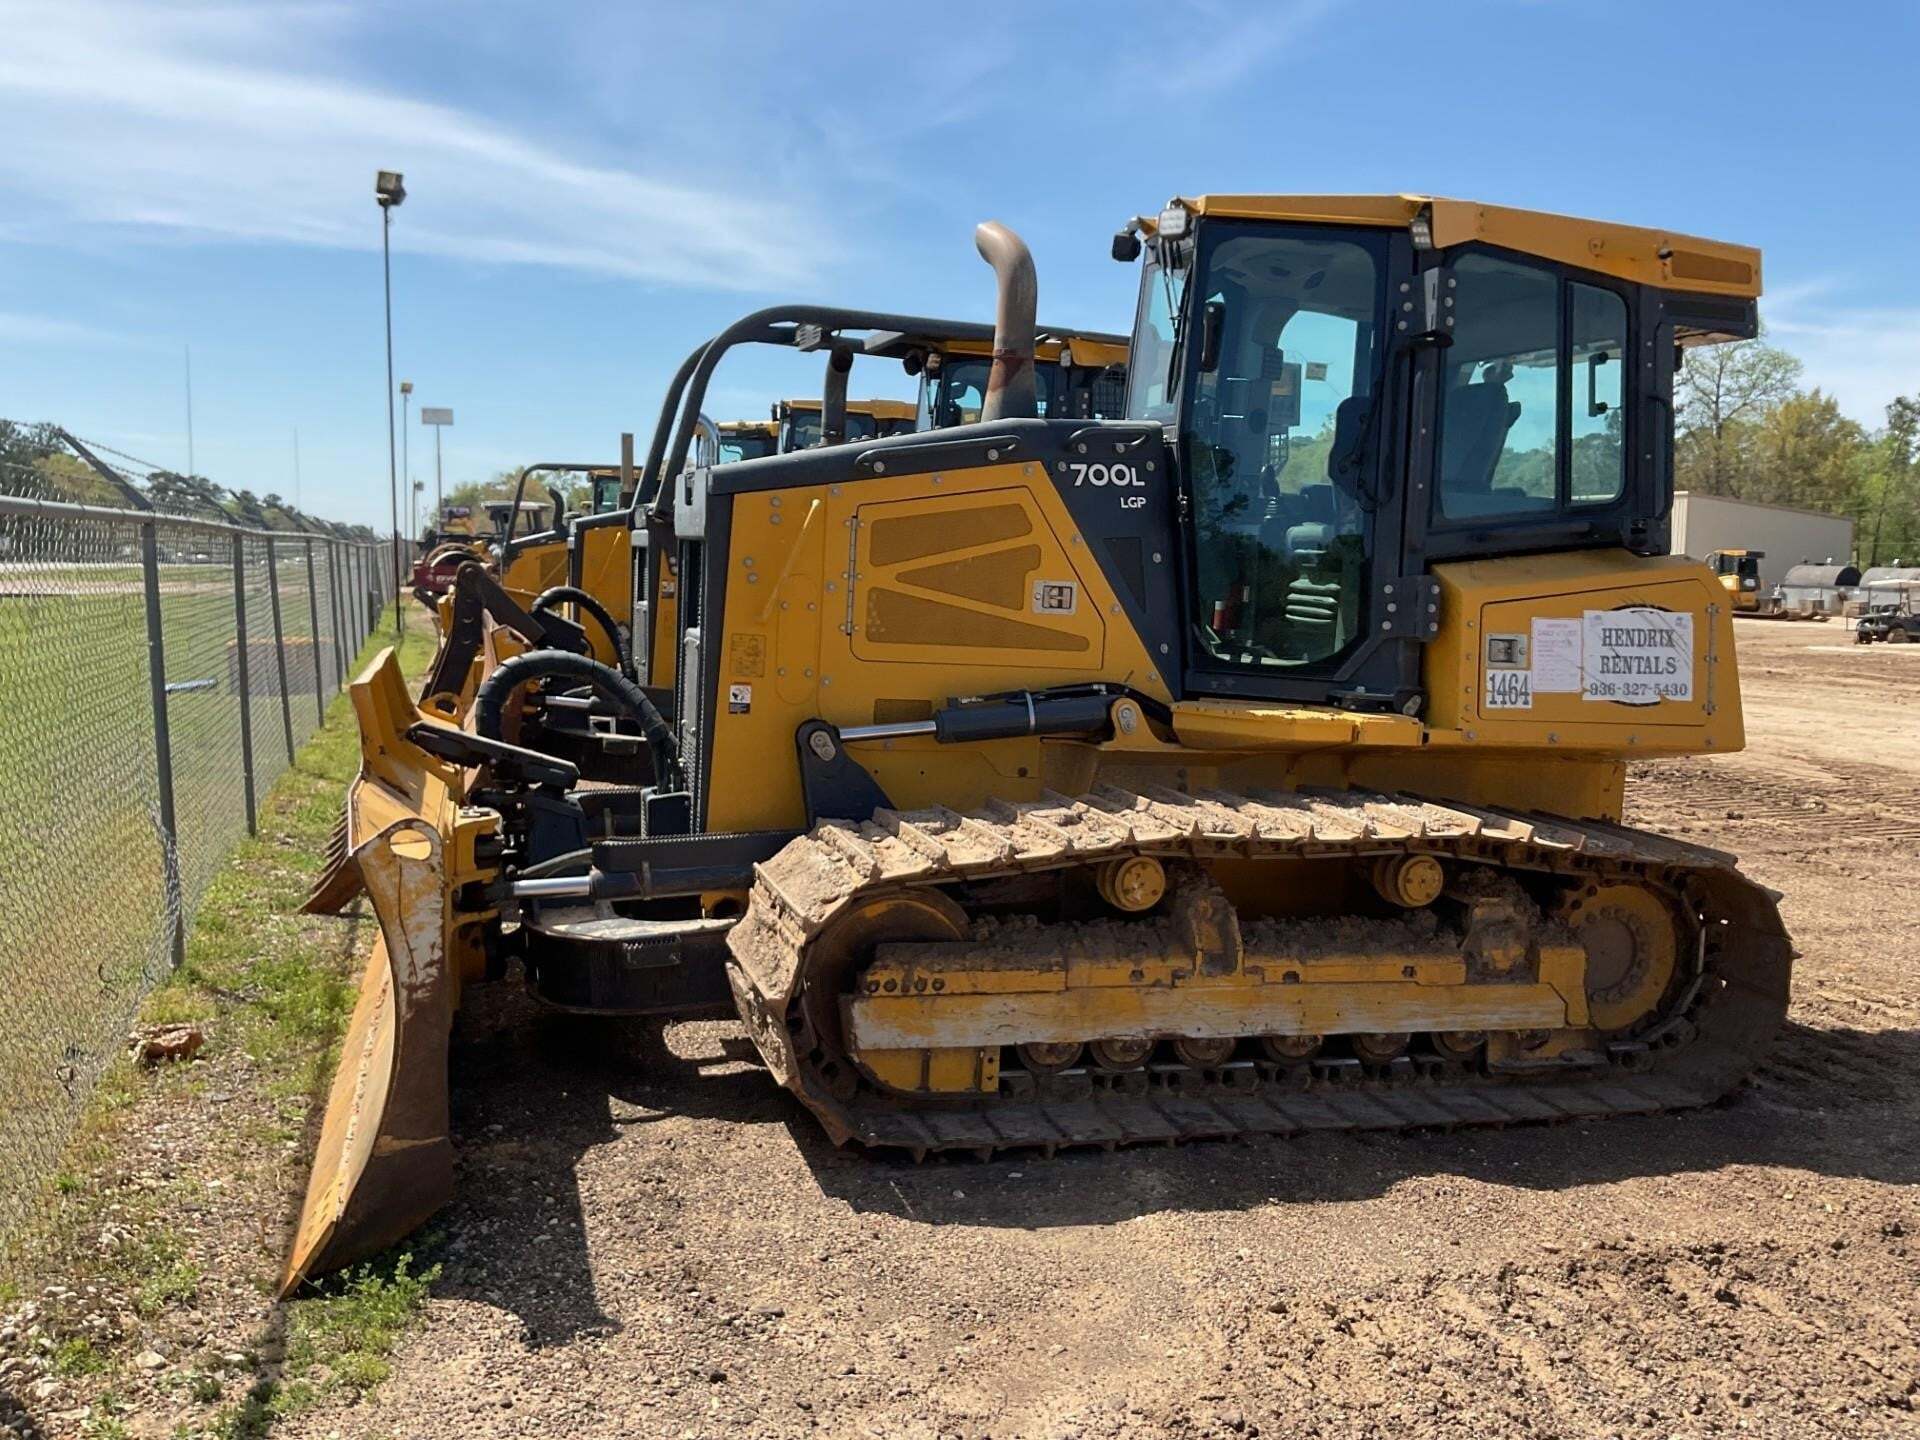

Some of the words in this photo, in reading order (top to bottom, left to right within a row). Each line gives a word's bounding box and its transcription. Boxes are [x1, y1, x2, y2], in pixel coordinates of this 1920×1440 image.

[1069, 463, 1146, 487] 700L
[1120, 496, 1147, 509] LGP
[1601, 627, 1676, 648] HENDRIX
[1599, 655, 1677, 675] RENTALS
[1488, 672, 1530, 706] 1464
[1589, 682, 1688, 697] 936-327-5430
